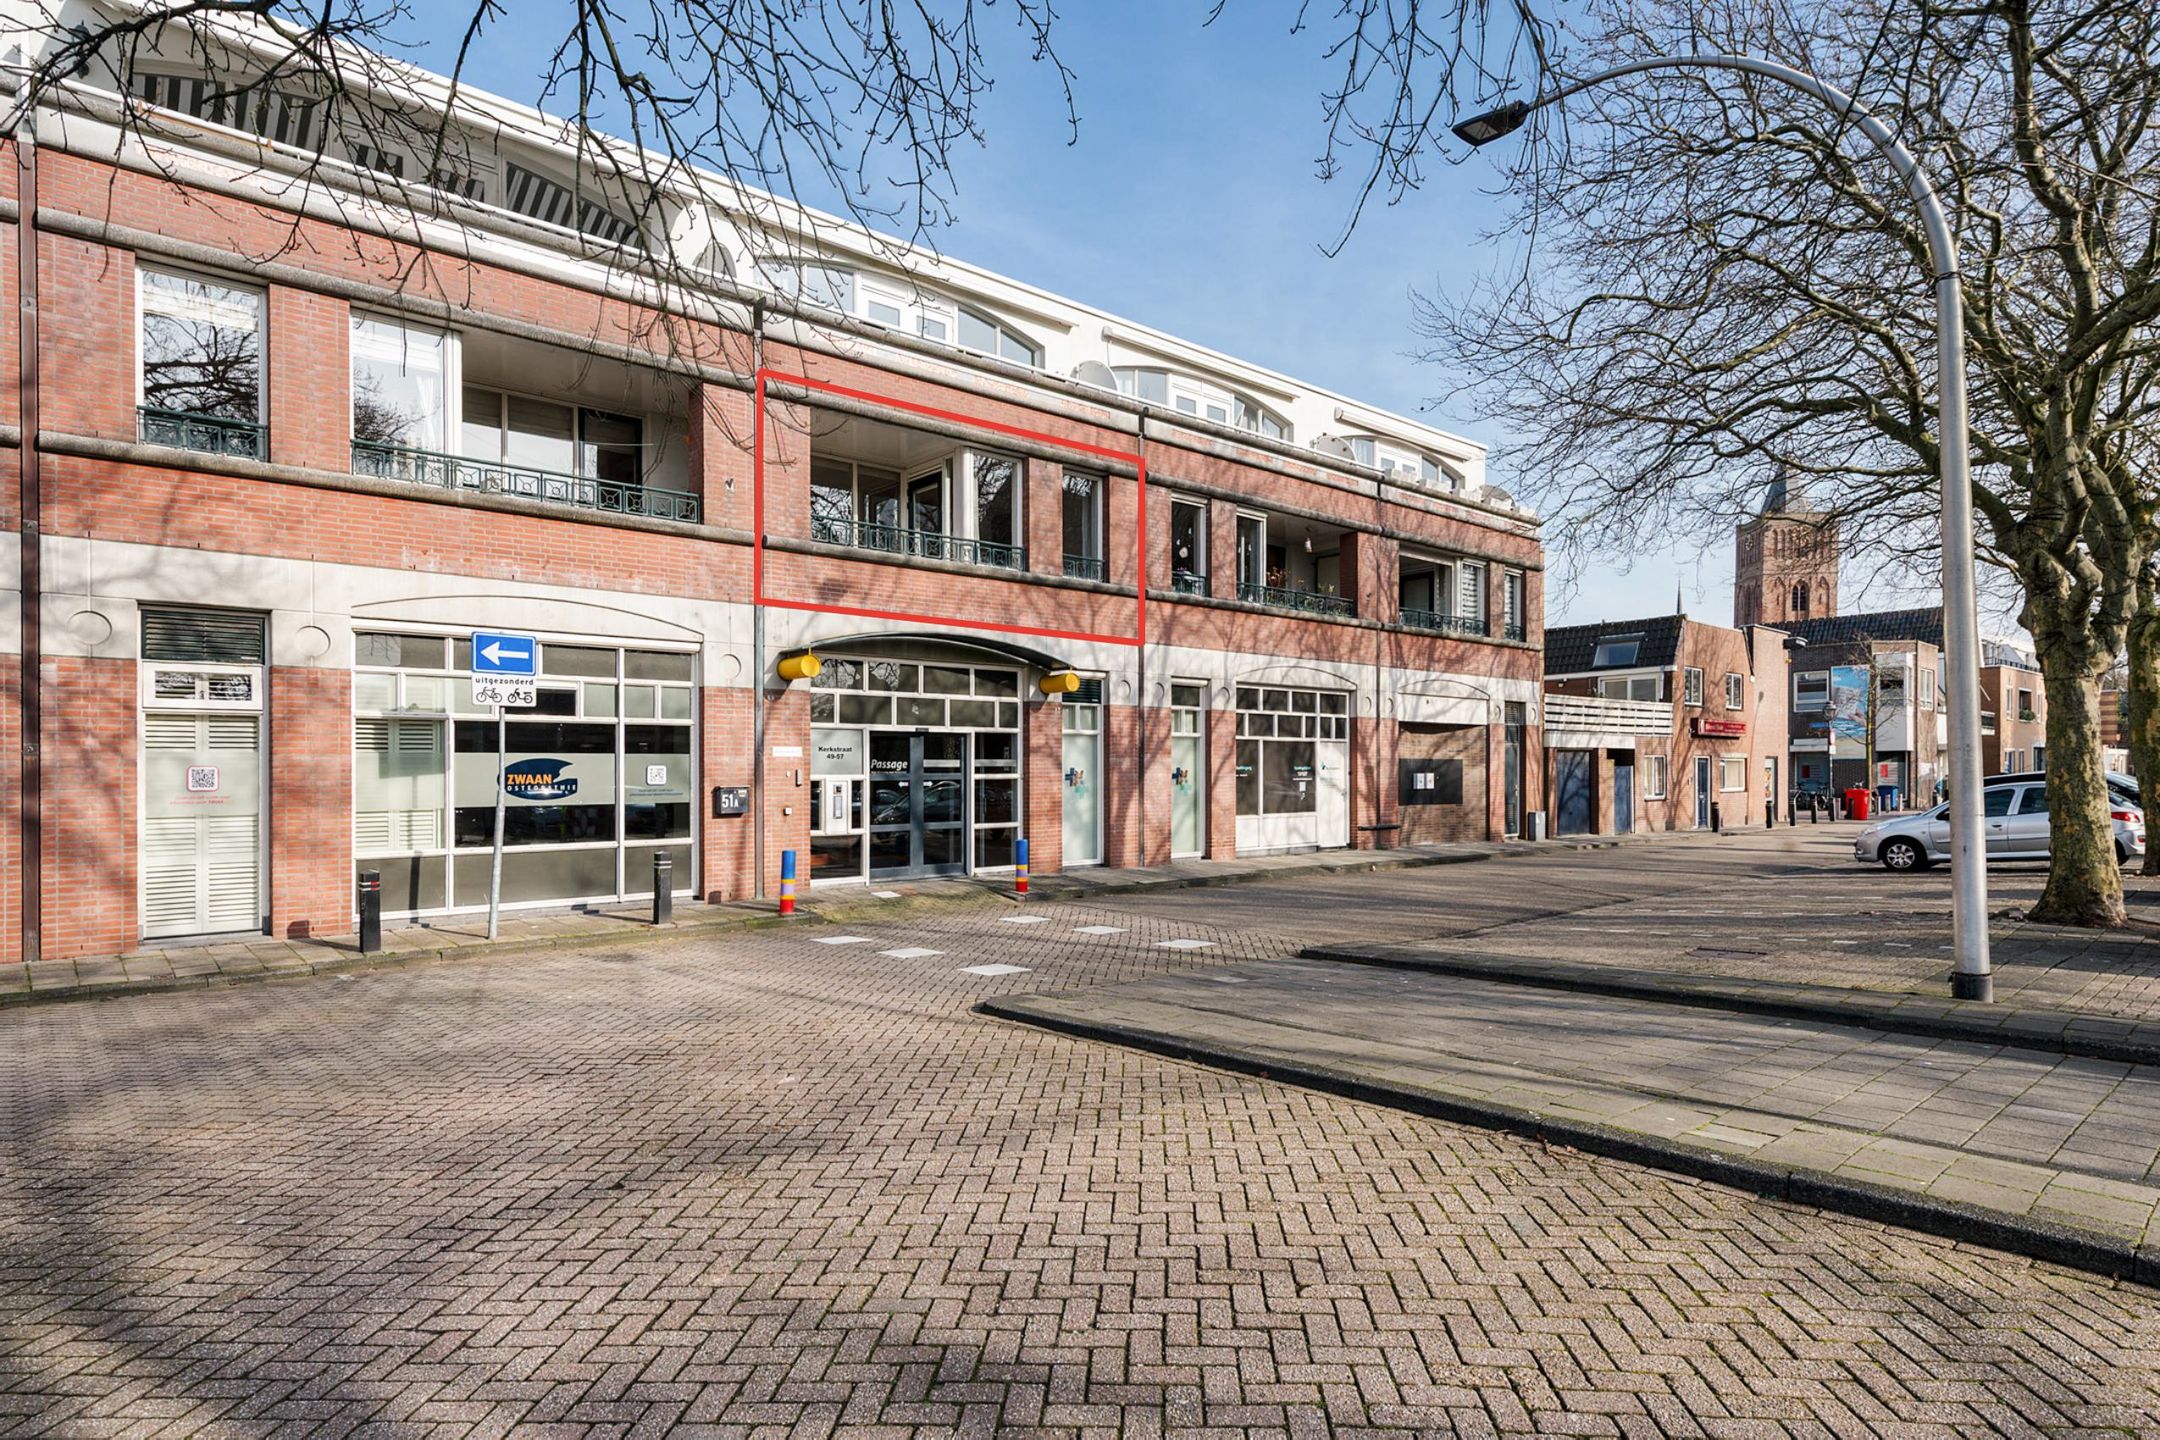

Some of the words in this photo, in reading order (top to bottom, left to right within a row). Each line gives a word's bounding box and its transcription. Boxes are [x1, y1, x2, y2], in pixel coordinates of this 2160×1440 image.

[475, 677, 534, 685] uitgezonderd
[871, 759, 908, 771] Passage
[507, 774, 552, 785] ZWAAN
